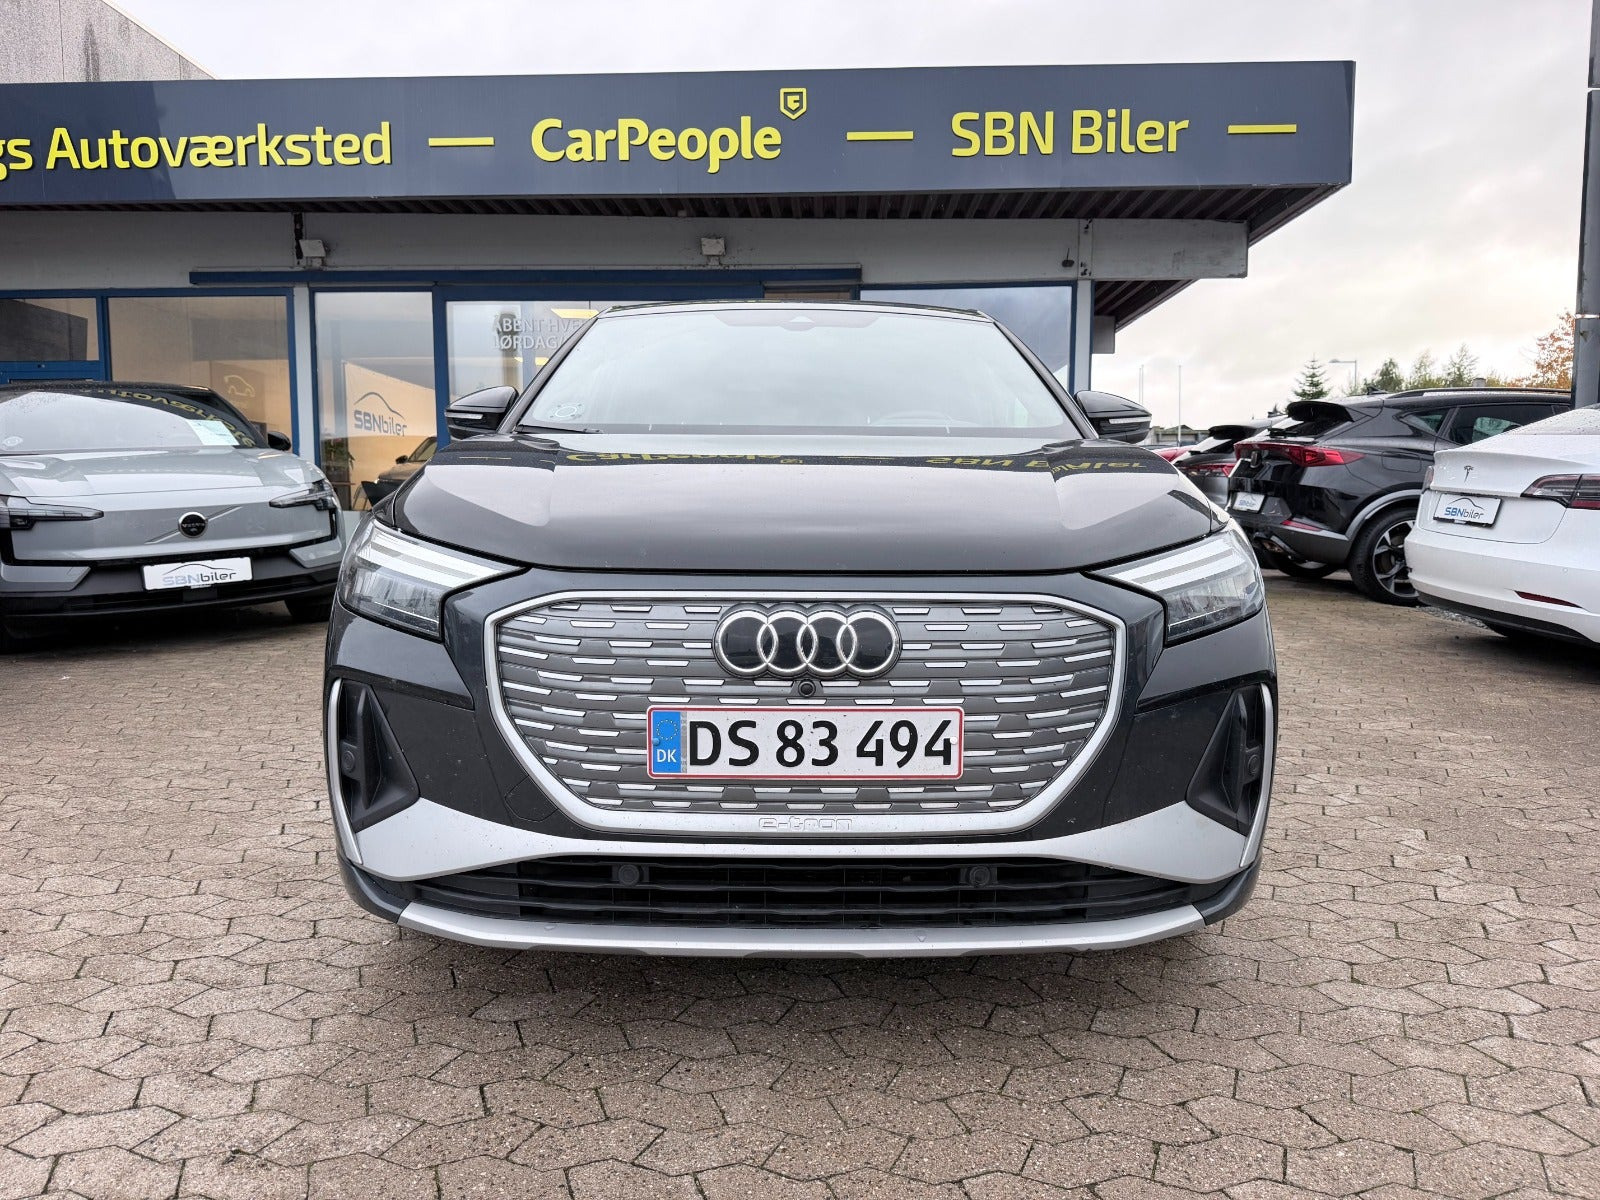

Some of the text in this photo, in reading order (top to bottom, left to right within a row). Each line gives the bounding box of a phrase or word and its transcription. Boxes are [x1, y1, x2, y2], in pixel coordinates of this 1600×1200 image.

[45, 121, 392, 170] Autoværksted
[531, 115, 783, 174] CarPeople
[951, 108, 1190, 157] SBN Biler
[162, 571, 238, 587] SBNbiler
[656, 748, 677, 763] DK
[689, 719, 952, 769] DS 83 494
[758, 815, 853, 832] e-tron
